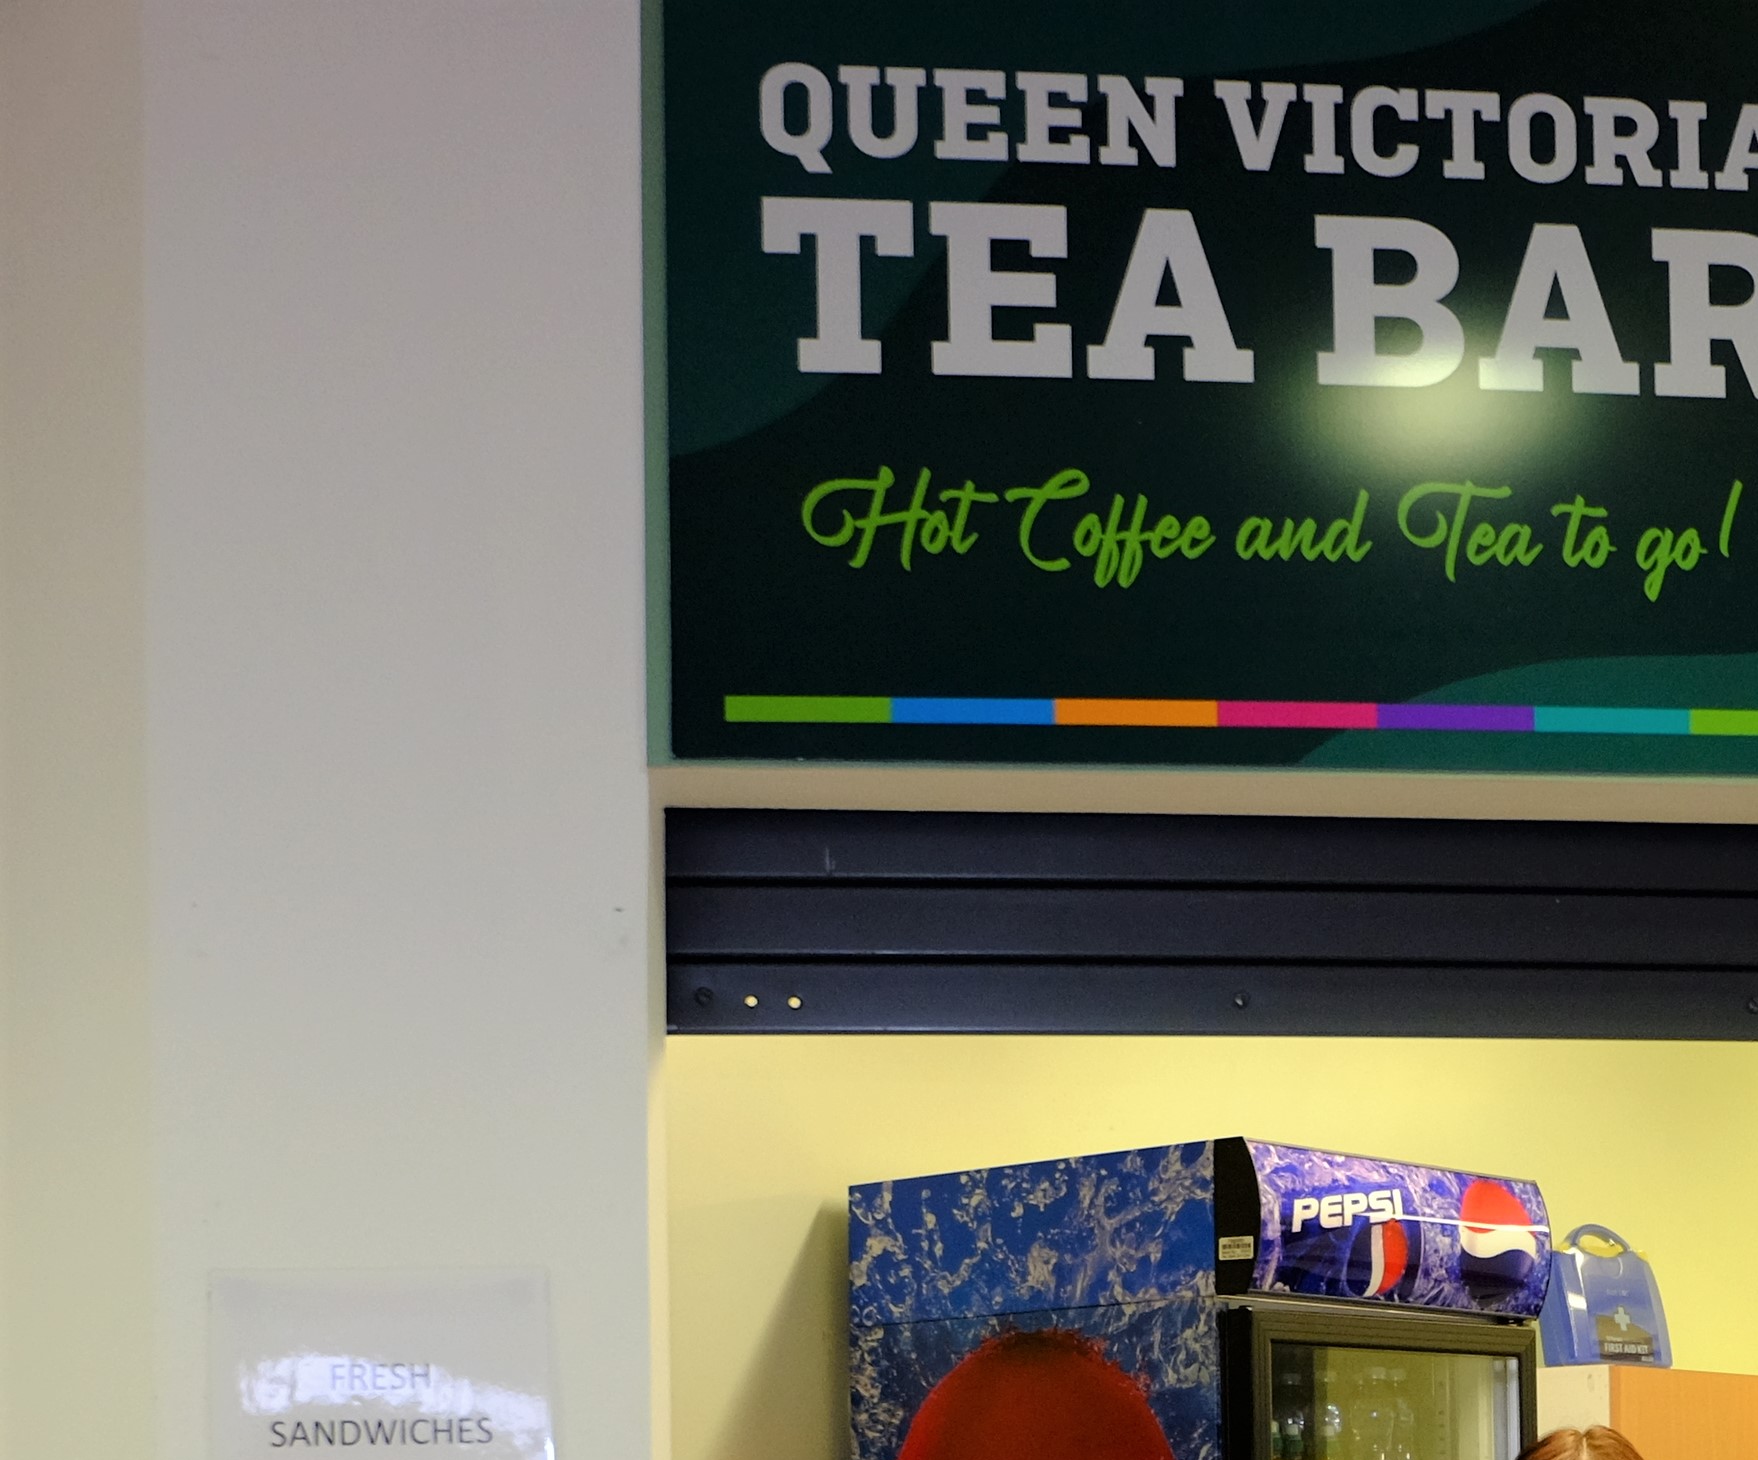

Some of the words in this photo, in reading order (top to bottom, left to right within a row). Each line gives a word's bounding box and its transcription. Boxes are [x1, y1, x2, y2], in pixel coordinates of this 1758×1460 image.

[759, 62, 1184, 174] QUEEN
[758, 195, 1257, 384] TEA
[802, 465, 999, 570] Hot
[1004, 468, 1216, 589] Coffee
[1235, 488, 1373, 562] and
[1396, 479, 1544, 581] Tea
[1551, 495, 1617, 569] to
[1635, 479, 1743, 603] go!
[1292, 1189, 1403, 1232] PEPSI
[1604, 1342, 1623, 1353] FIRST
[1624, 1344, 1636, 1353] AID
[1638, 1344, 1648, 1354] KIT
[330, 1363, 431, 1391] FRESH
[270, 1418, 494, 1448] SANDWICHES
